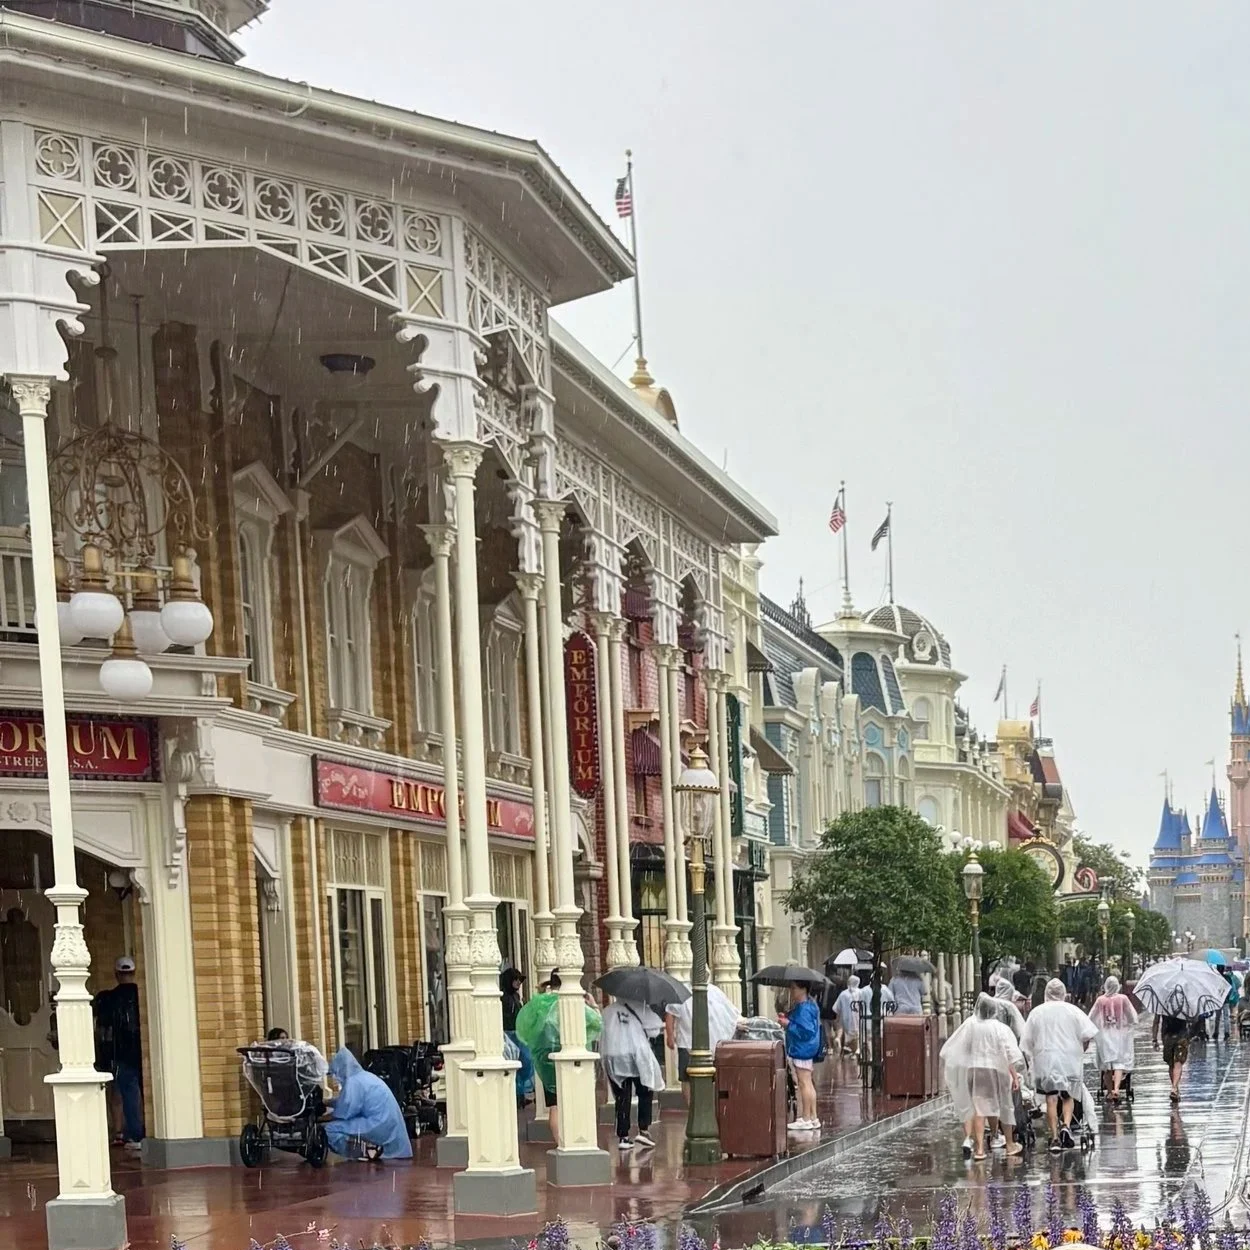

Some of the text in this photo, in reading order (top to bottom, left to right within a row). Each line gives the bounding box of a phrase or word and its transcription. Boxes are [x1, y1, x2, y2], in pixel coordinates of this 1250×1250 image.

[570, 650, 595, 781] EMPORIUM
[0, 720, 138, 761] ORUM
[0, 755, 45, 767] TREE
